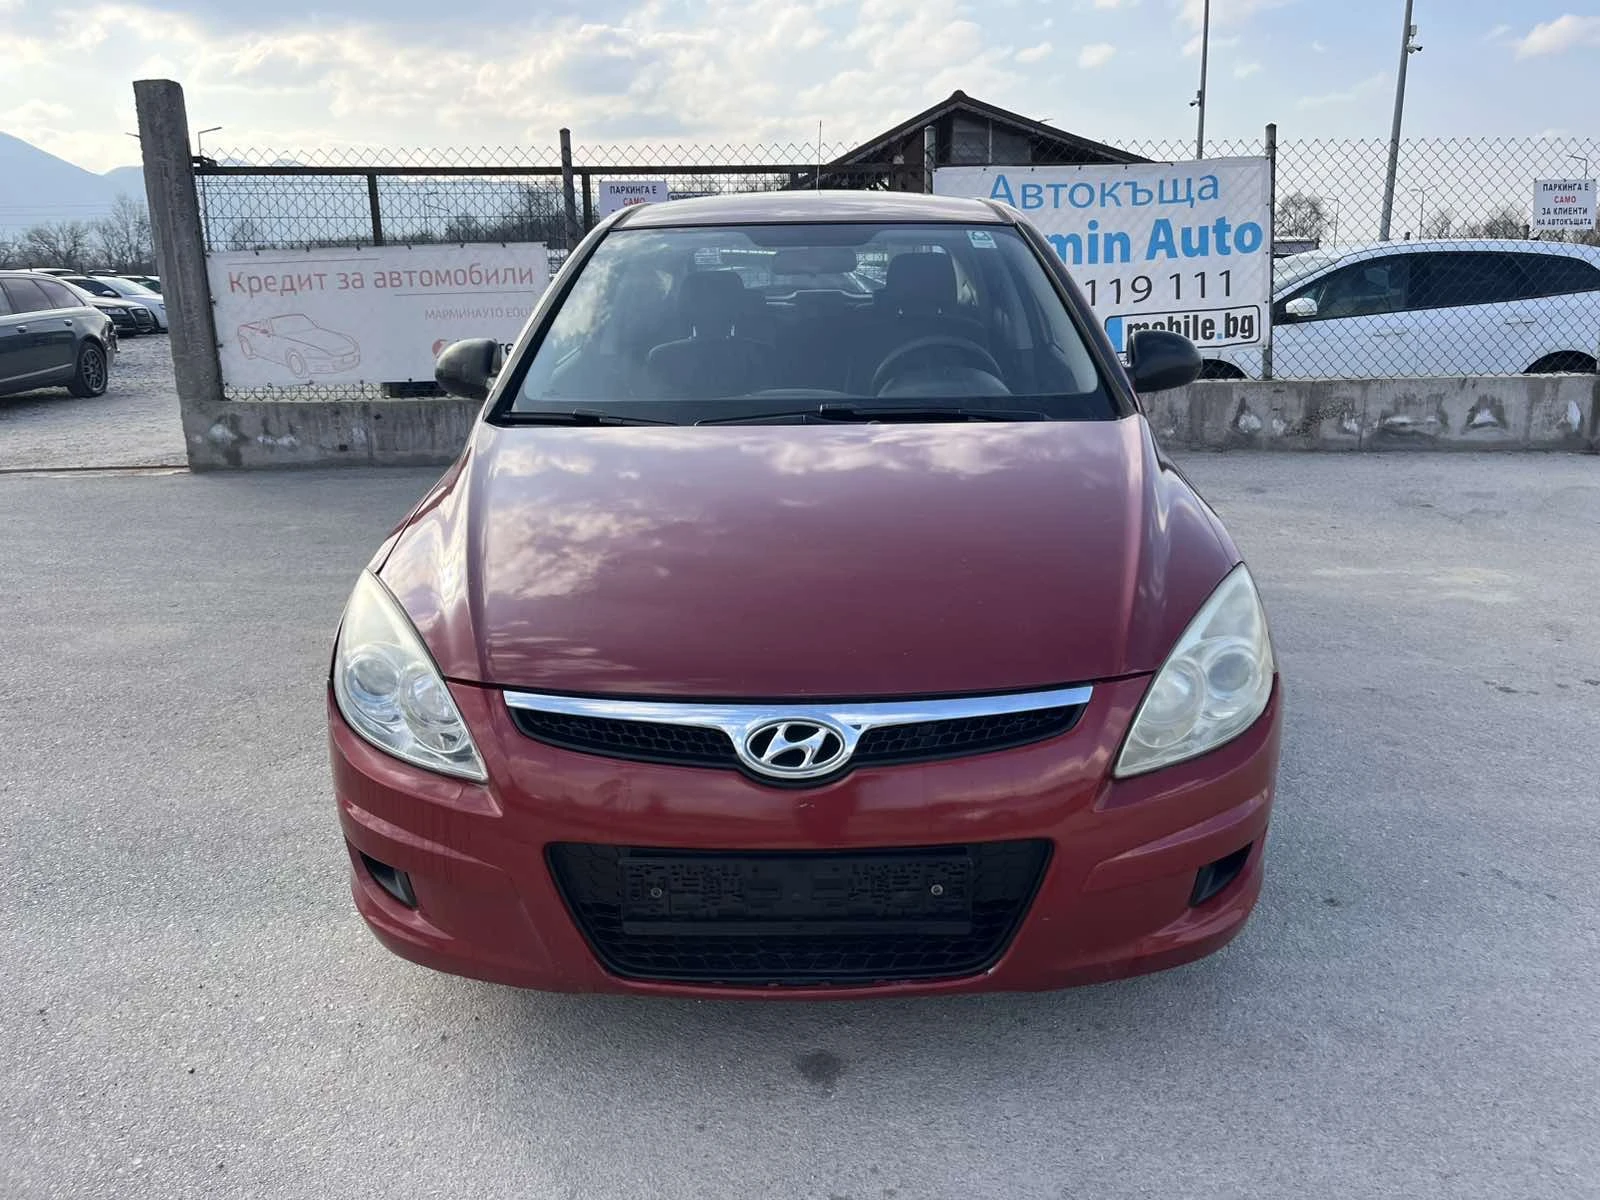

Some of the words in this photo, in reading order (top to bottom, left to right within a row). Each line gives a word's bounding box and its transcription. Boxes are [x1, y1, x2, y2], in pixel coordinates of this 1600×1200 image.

[610, 186, 650, 195] ПАРКИНГА
[652, 185, 657, 194] Е
[990, 174, 1219, 209] Автокъща
[1543, 184, 1582, 192] ПАРКИНГА
[1584, 183, 1589, 191] Е
[624, 197, 646, 206] САМО
[1554, 196, 1576, 204] САМО
[1542, 207, 1551, 215] ЗА
[1553, 207, 1588, 215] КЛИЕНТИ
[1536, 218, 1545, 226] НА
[1547, 218, 1592, 226] АВТОКЪЩАТА
[1146, 216, 1263, 261] Auto
[228, 271, 327, 297] Кредит
[337, 273, 364, 290] за
[374, 263, 534, 288] автомобили
[1085, 275, 1153, 306] 119
[1170, 270, 1231, 300] 111
